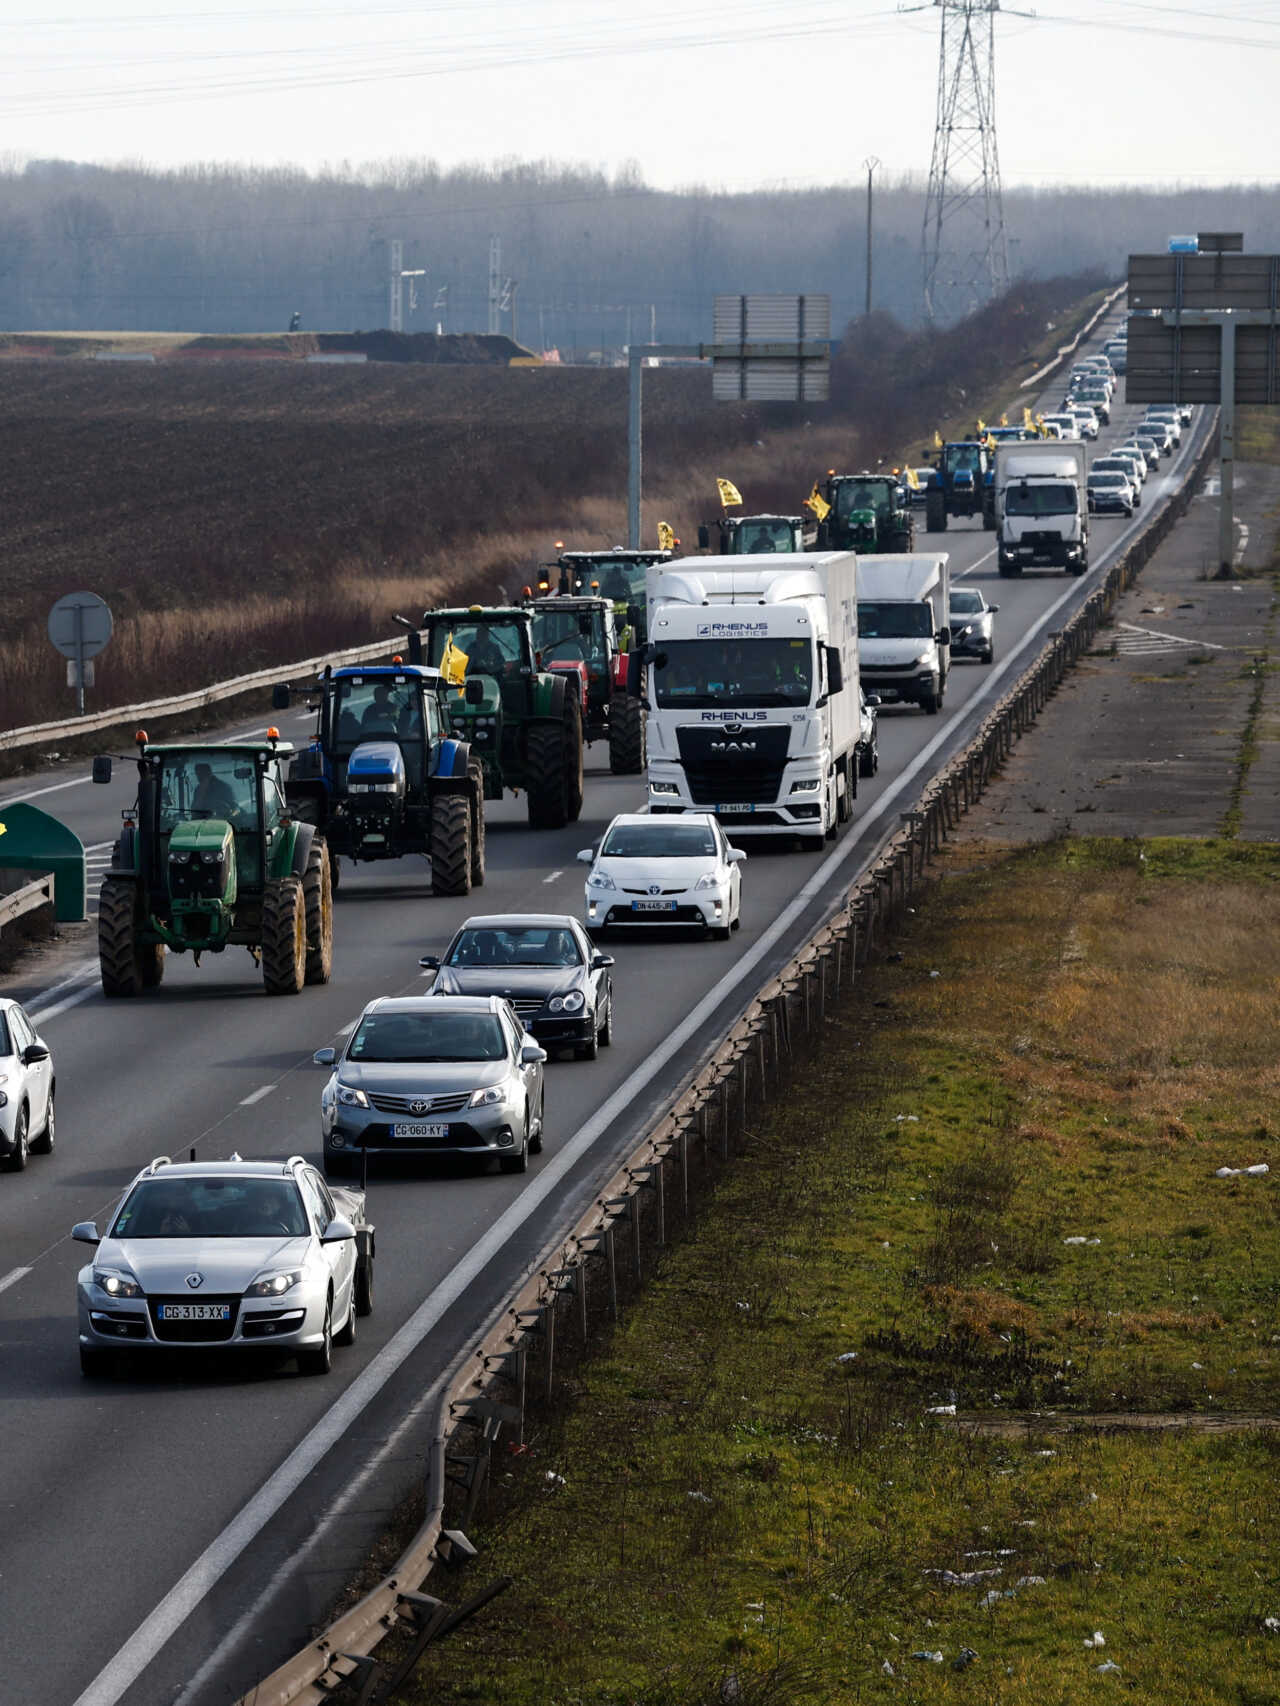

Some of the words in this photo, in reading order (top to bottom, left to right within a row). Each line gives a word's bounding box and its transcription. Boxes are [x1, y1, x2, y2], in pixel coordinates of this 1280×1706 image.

[701, 712, 767, 720] RHENUS
[711, 742, 756, 751] MAN
[395, 1125, 441, 1136] CG-060-KY
[164, 1306, 223, 1319] CG-313-XX
